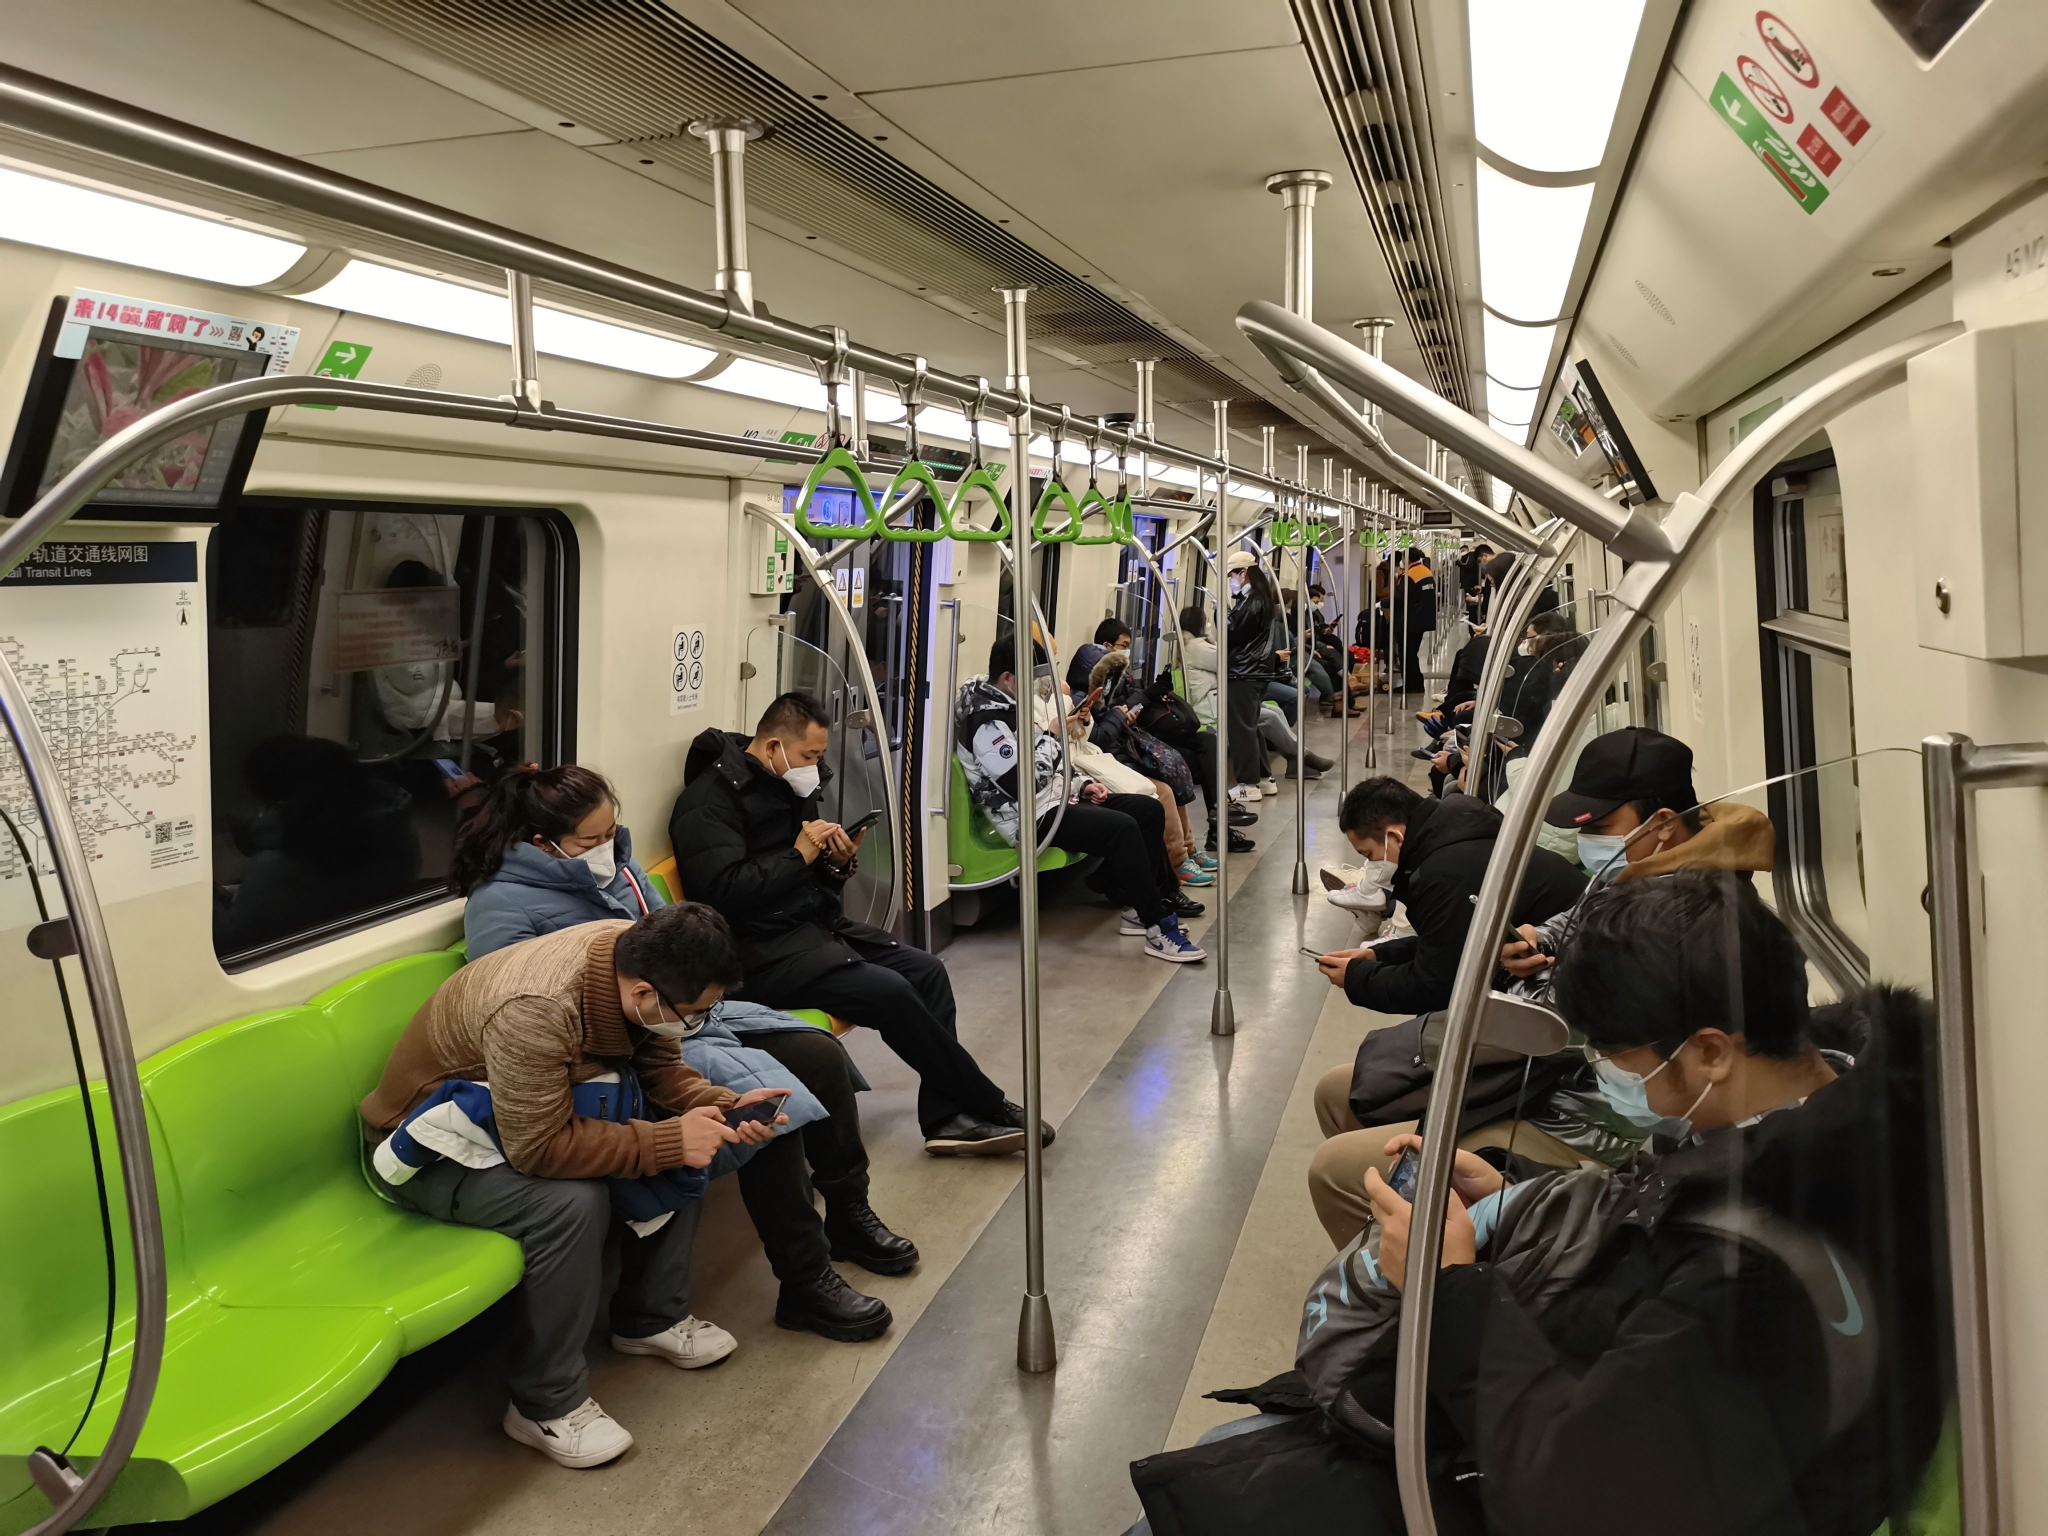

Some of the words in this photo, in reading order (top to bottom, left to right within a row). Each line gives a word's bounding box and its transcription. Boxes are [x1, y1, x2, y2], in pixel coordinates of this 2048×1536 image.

[25, 566, 61, 578] Transit
[64, 567, 92, 578] Lines
[179, 590, 188, 601] 北
